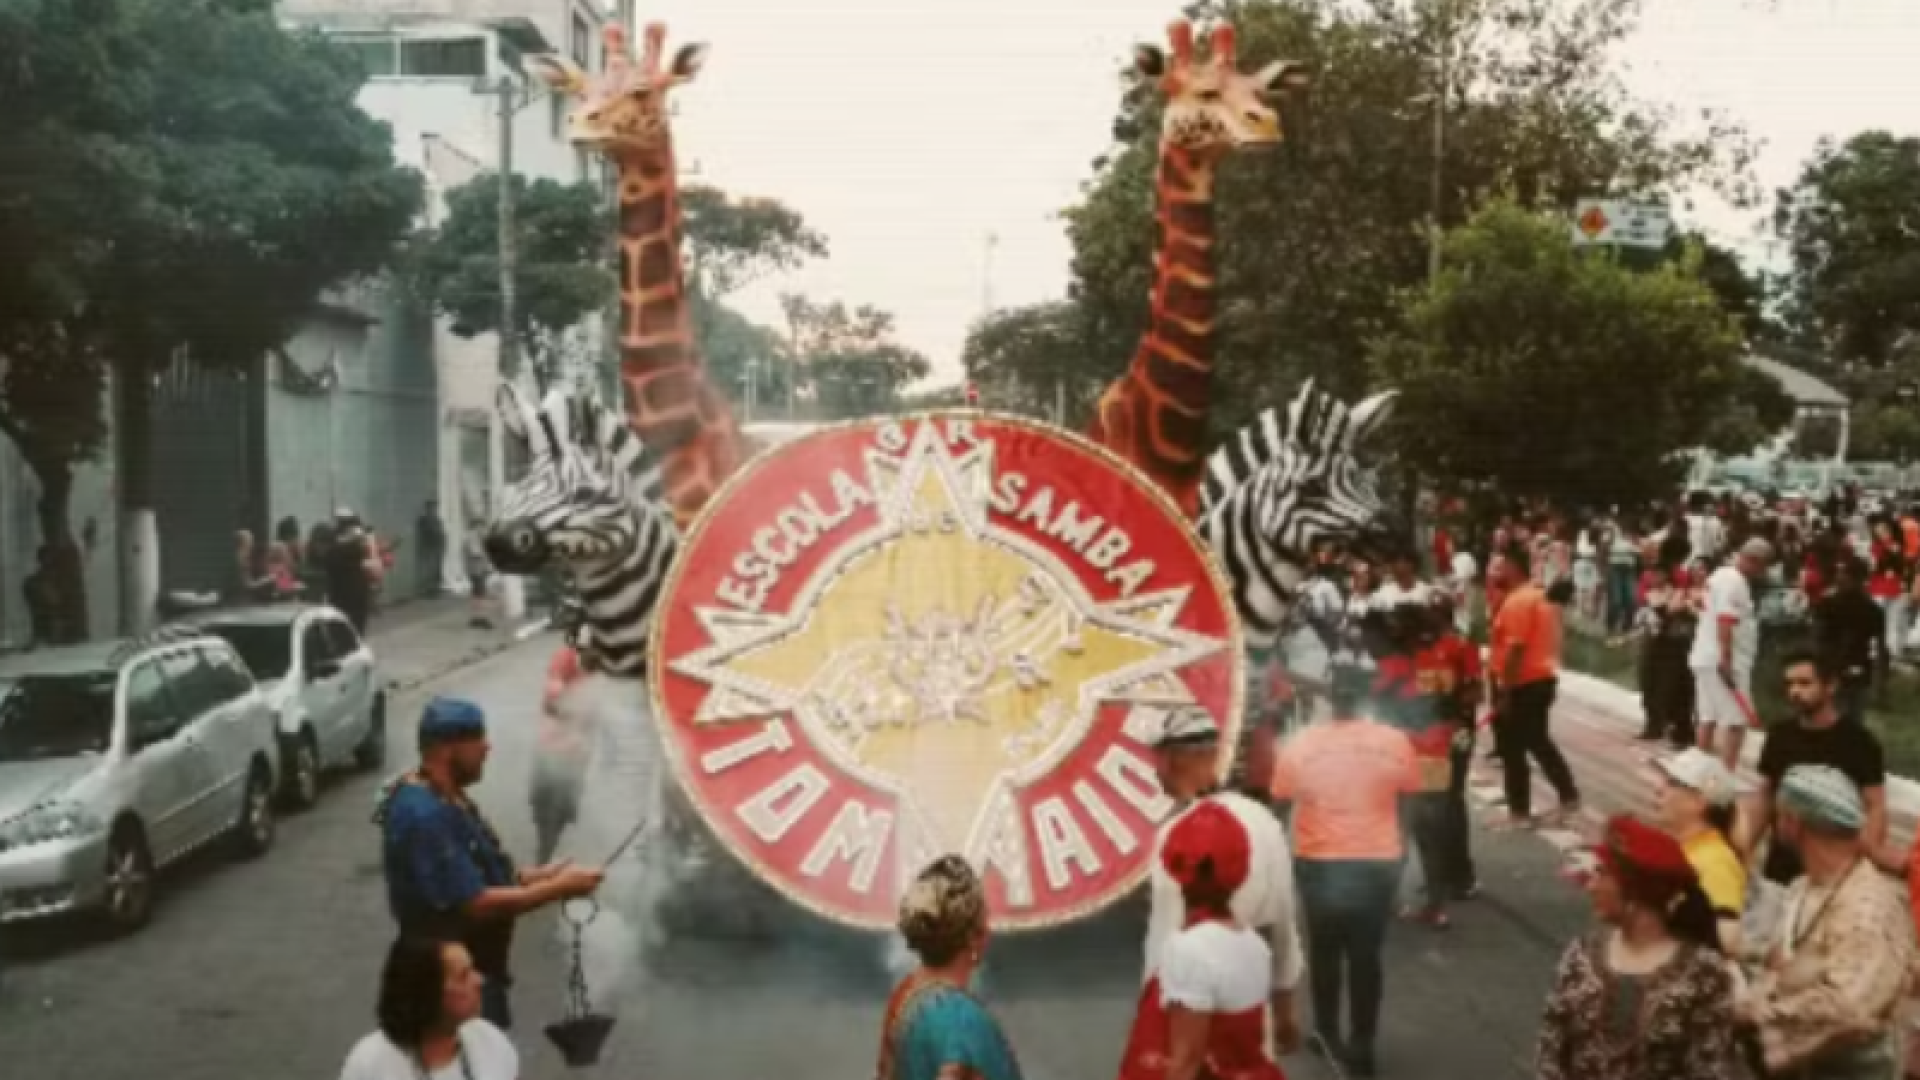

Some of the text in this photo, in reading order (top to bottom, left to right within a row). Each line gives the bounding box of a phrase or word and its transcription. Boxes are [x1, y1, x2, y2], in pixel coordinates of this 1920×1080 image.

[714, 468, 877, 612] ESCOLA
[991, 471, 1157, 600] SAMBA
[701, 716, 893, 892] TOM
